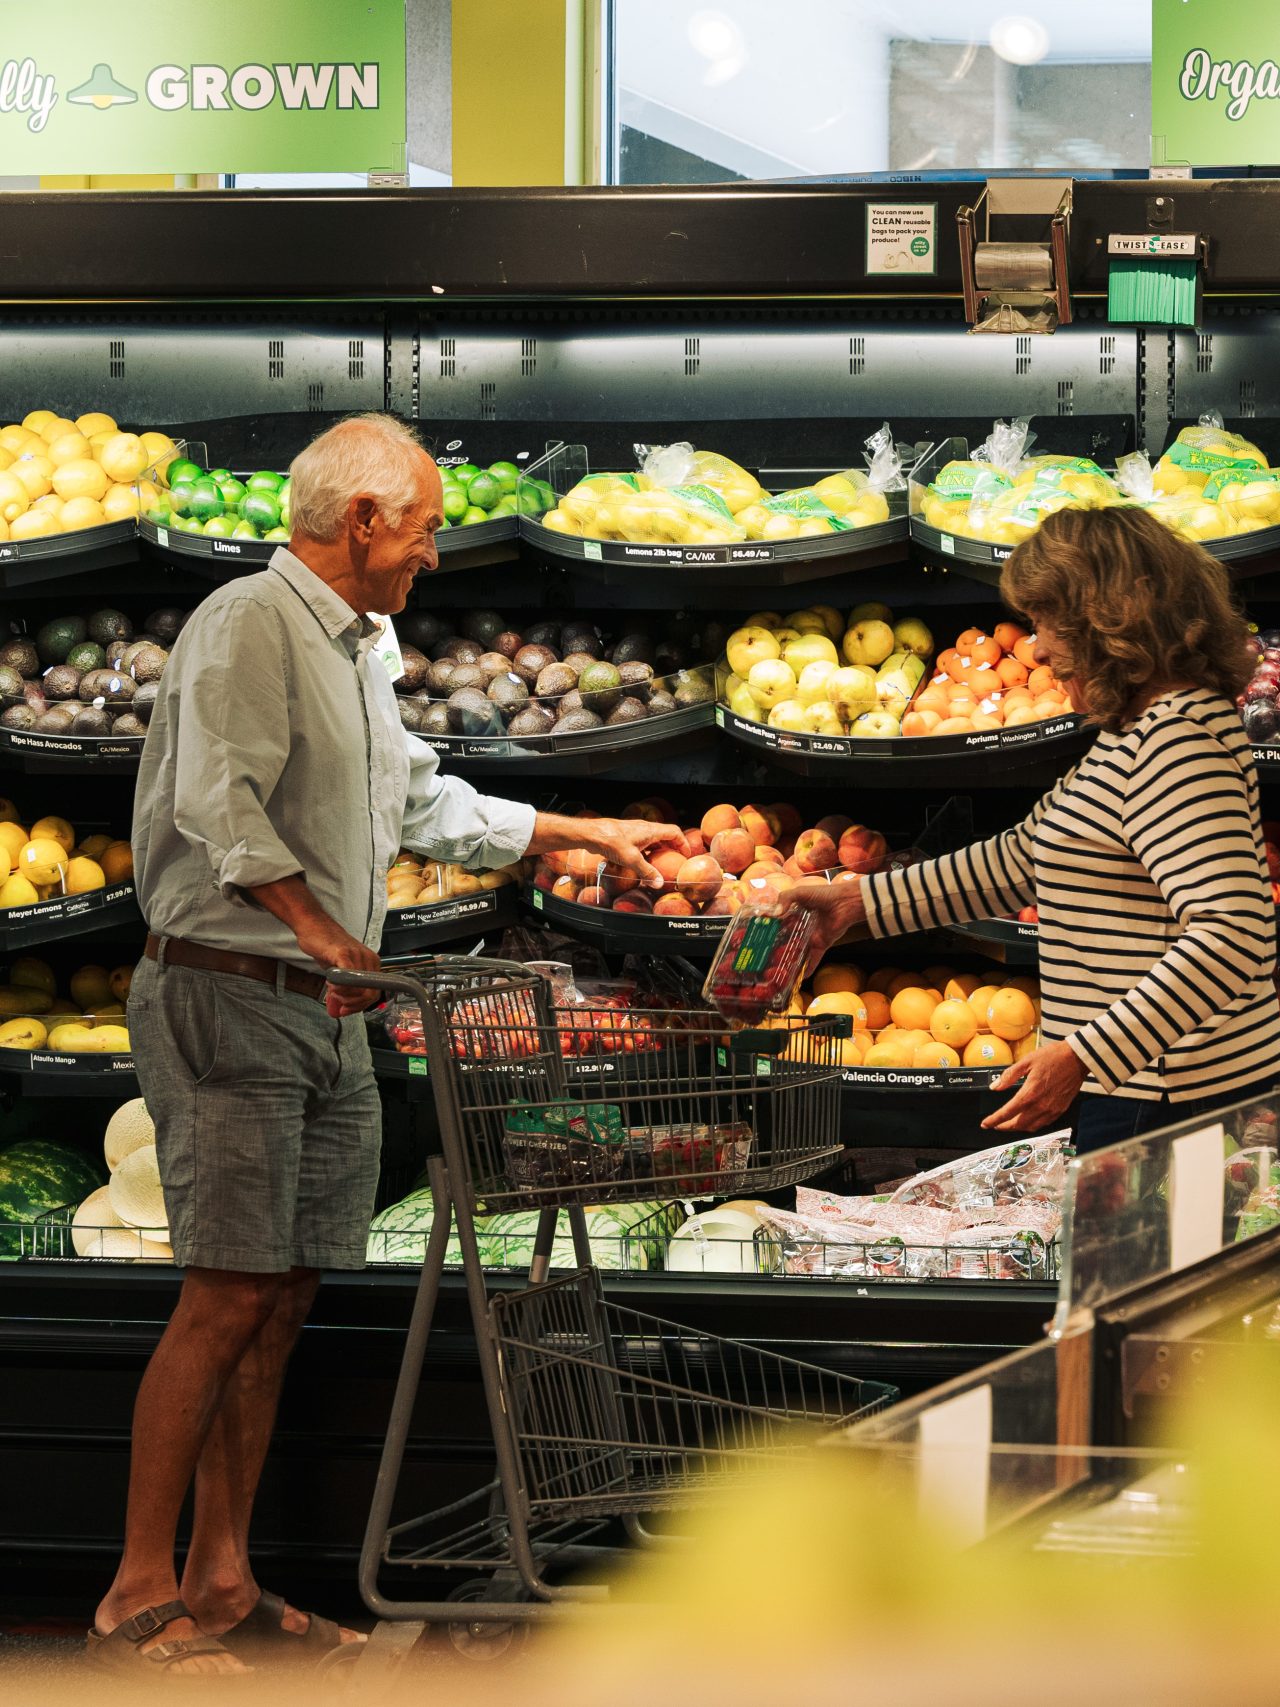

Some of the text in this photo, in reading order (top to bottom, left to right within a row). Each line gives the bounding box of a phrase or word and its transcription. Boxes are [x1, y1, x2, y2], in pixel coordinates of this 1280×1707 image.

[145, 62, 380, 111] GROWN
[872, 217, 902, 225] CLEAN
[214, 541, 241, 553] Limes
[626, 547, 653, 557] Lemons
[666, 548, 682, 559] bag
[686, 552, 716, 561] CA/MX
[11, 735, 26, 745] Ripe
[27, 738, 44, 747] Hass
[45, 740, 82, 750] Avocados
[966, 734, 998, 745] Apriums
[1002, 732, 1037, 743] Washington
[8, 907, 33, 919] Meyer
[33, 904, 62, 915] Lemons
[66, 901, 89, 911] California
[400, 912, 416, 921] Kiwi
[668, 921, 699, 930] Peaches
[55, 1056, 76, 1065] Mango
[841, 1071, 973, 1085] Valencia Oranges California
